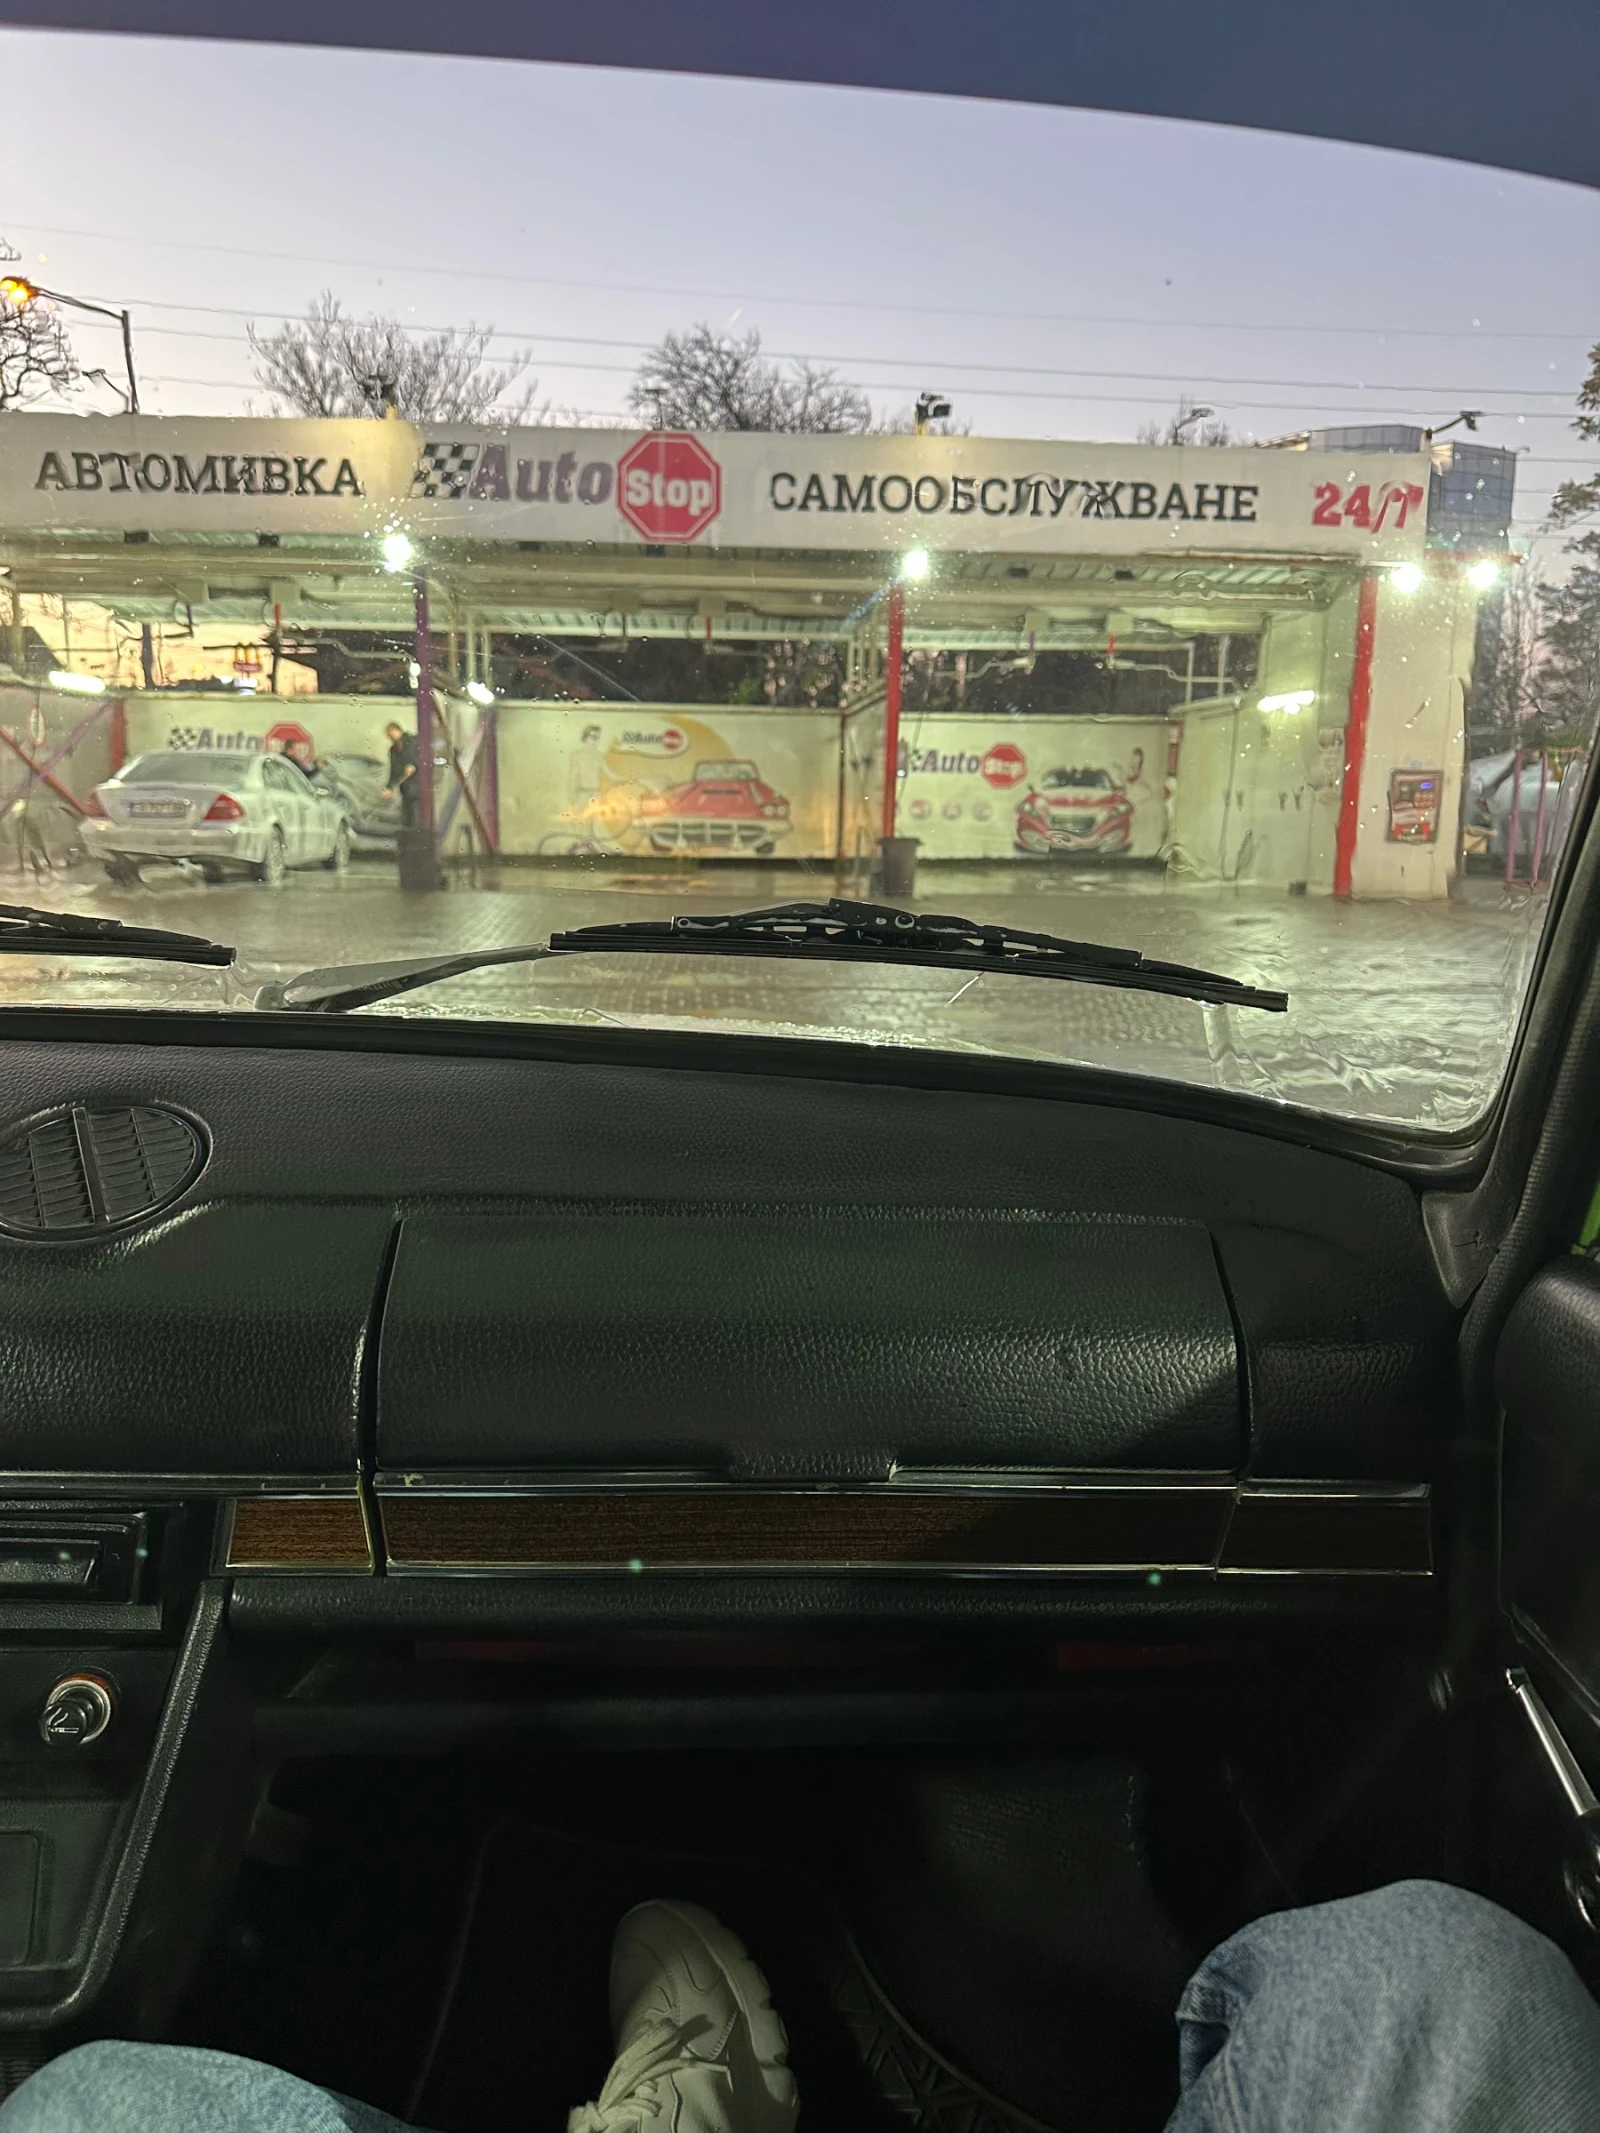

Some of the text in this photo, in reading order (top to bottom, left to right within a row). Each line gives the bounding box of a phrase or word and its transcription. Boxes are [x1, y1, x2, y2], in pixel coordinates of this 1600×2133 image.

[34, 452, 364, 496] АВТОМИВКА
[469, 443, 711, 516] Auto Stop
[770, 472, 1258, 522] САМООБСЛУЖВАНЕ
[1311, 481, 1424, 533] 24/7
[196, 728, 261, 749] Auto
[921, 749, 981, 773] Auto
